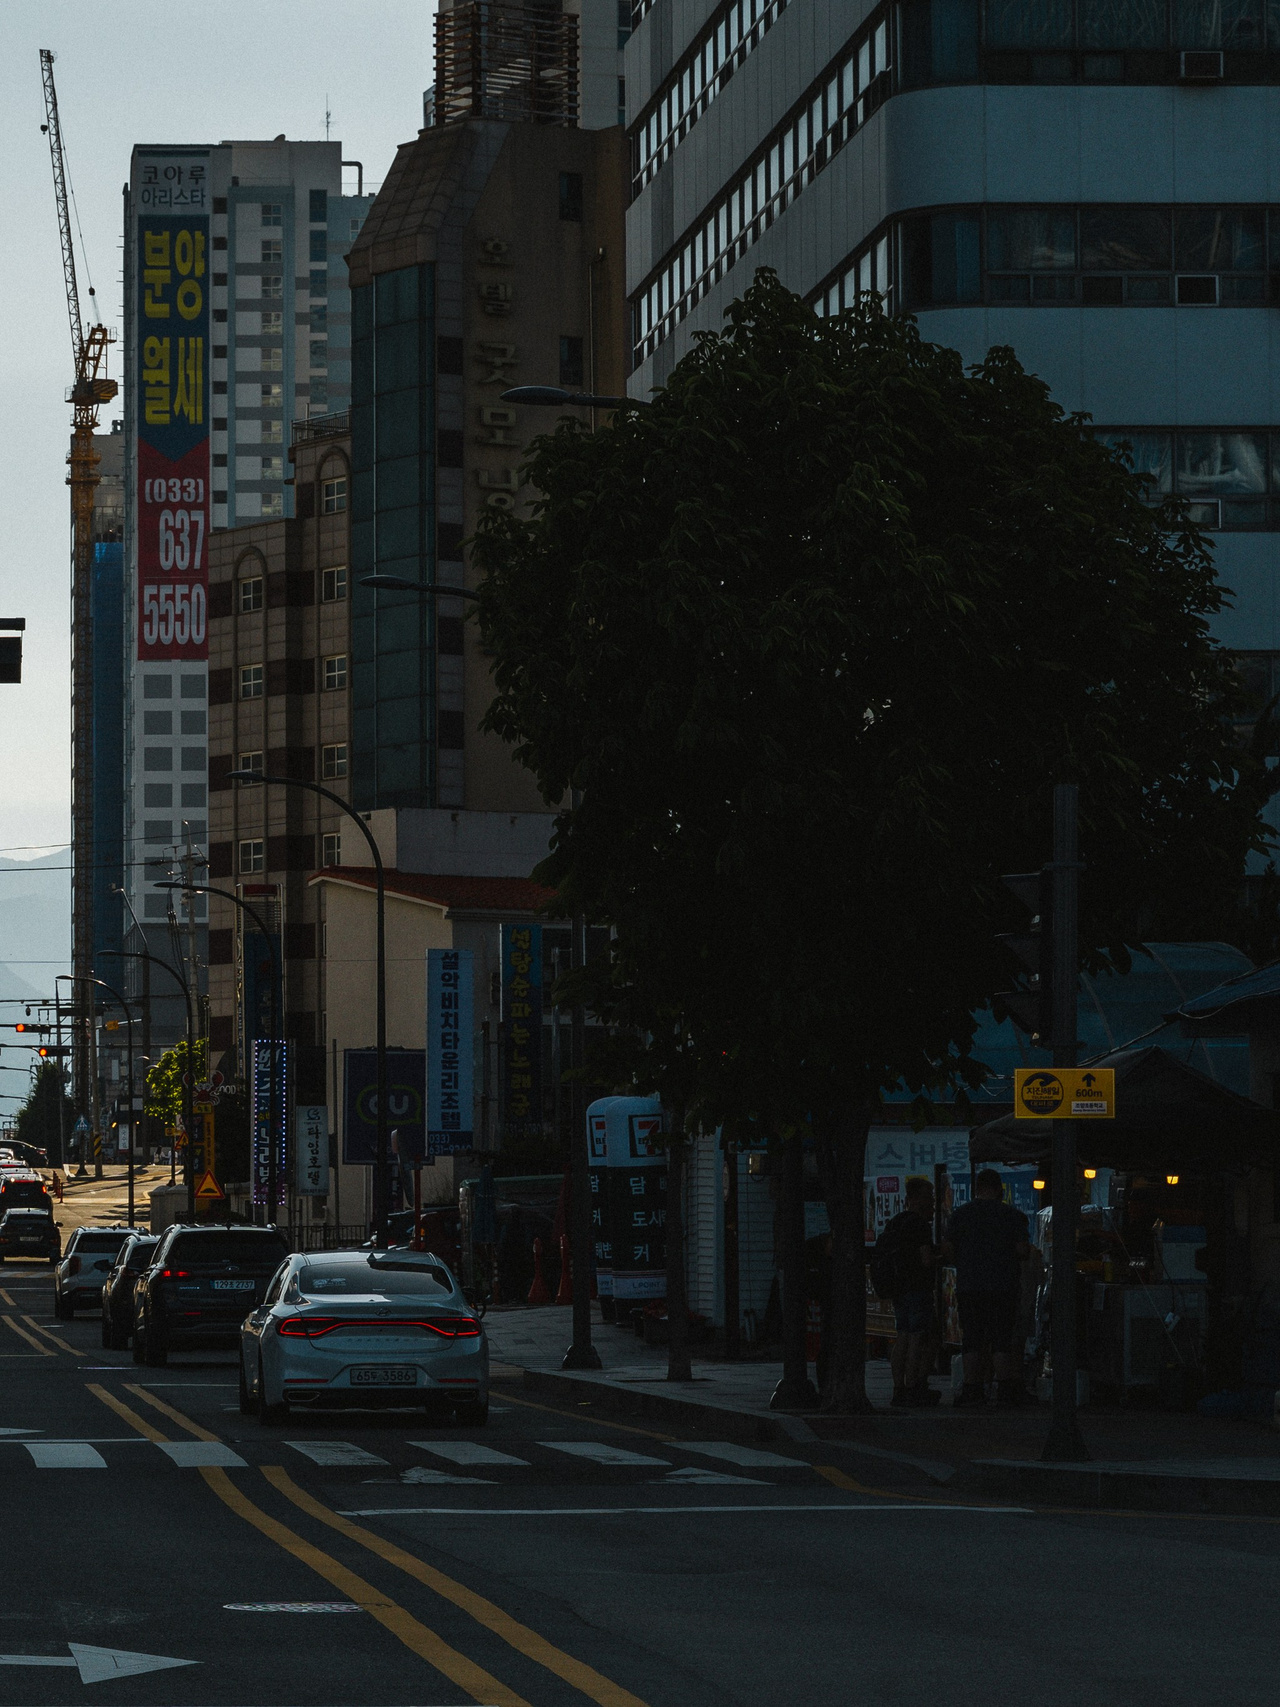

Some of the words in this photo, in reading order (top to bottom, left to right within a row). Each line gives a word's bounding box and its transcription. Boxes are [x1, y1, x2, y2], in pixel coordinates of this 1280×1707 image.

[141, 165, 207, 186] 코아루
[141, 187, 206, 208] 아리스타
[143, 229, 205, 321] 분양
[142, 335, 204, 425] 월세
[144, 478, 205, 503] (033)
[159, 509, 205, 571] 637
[143, 583, 206, 646] 5550
[440, 951, 461, 1131] 설악비치타운리조텔
[1026, 1086, 1060, 1096] 지진해일
[1075, 1088, 1103, 1097] 600m
[368, 1094, 409, 1115] CU
[382, 1370, 411, 1381] 3586
